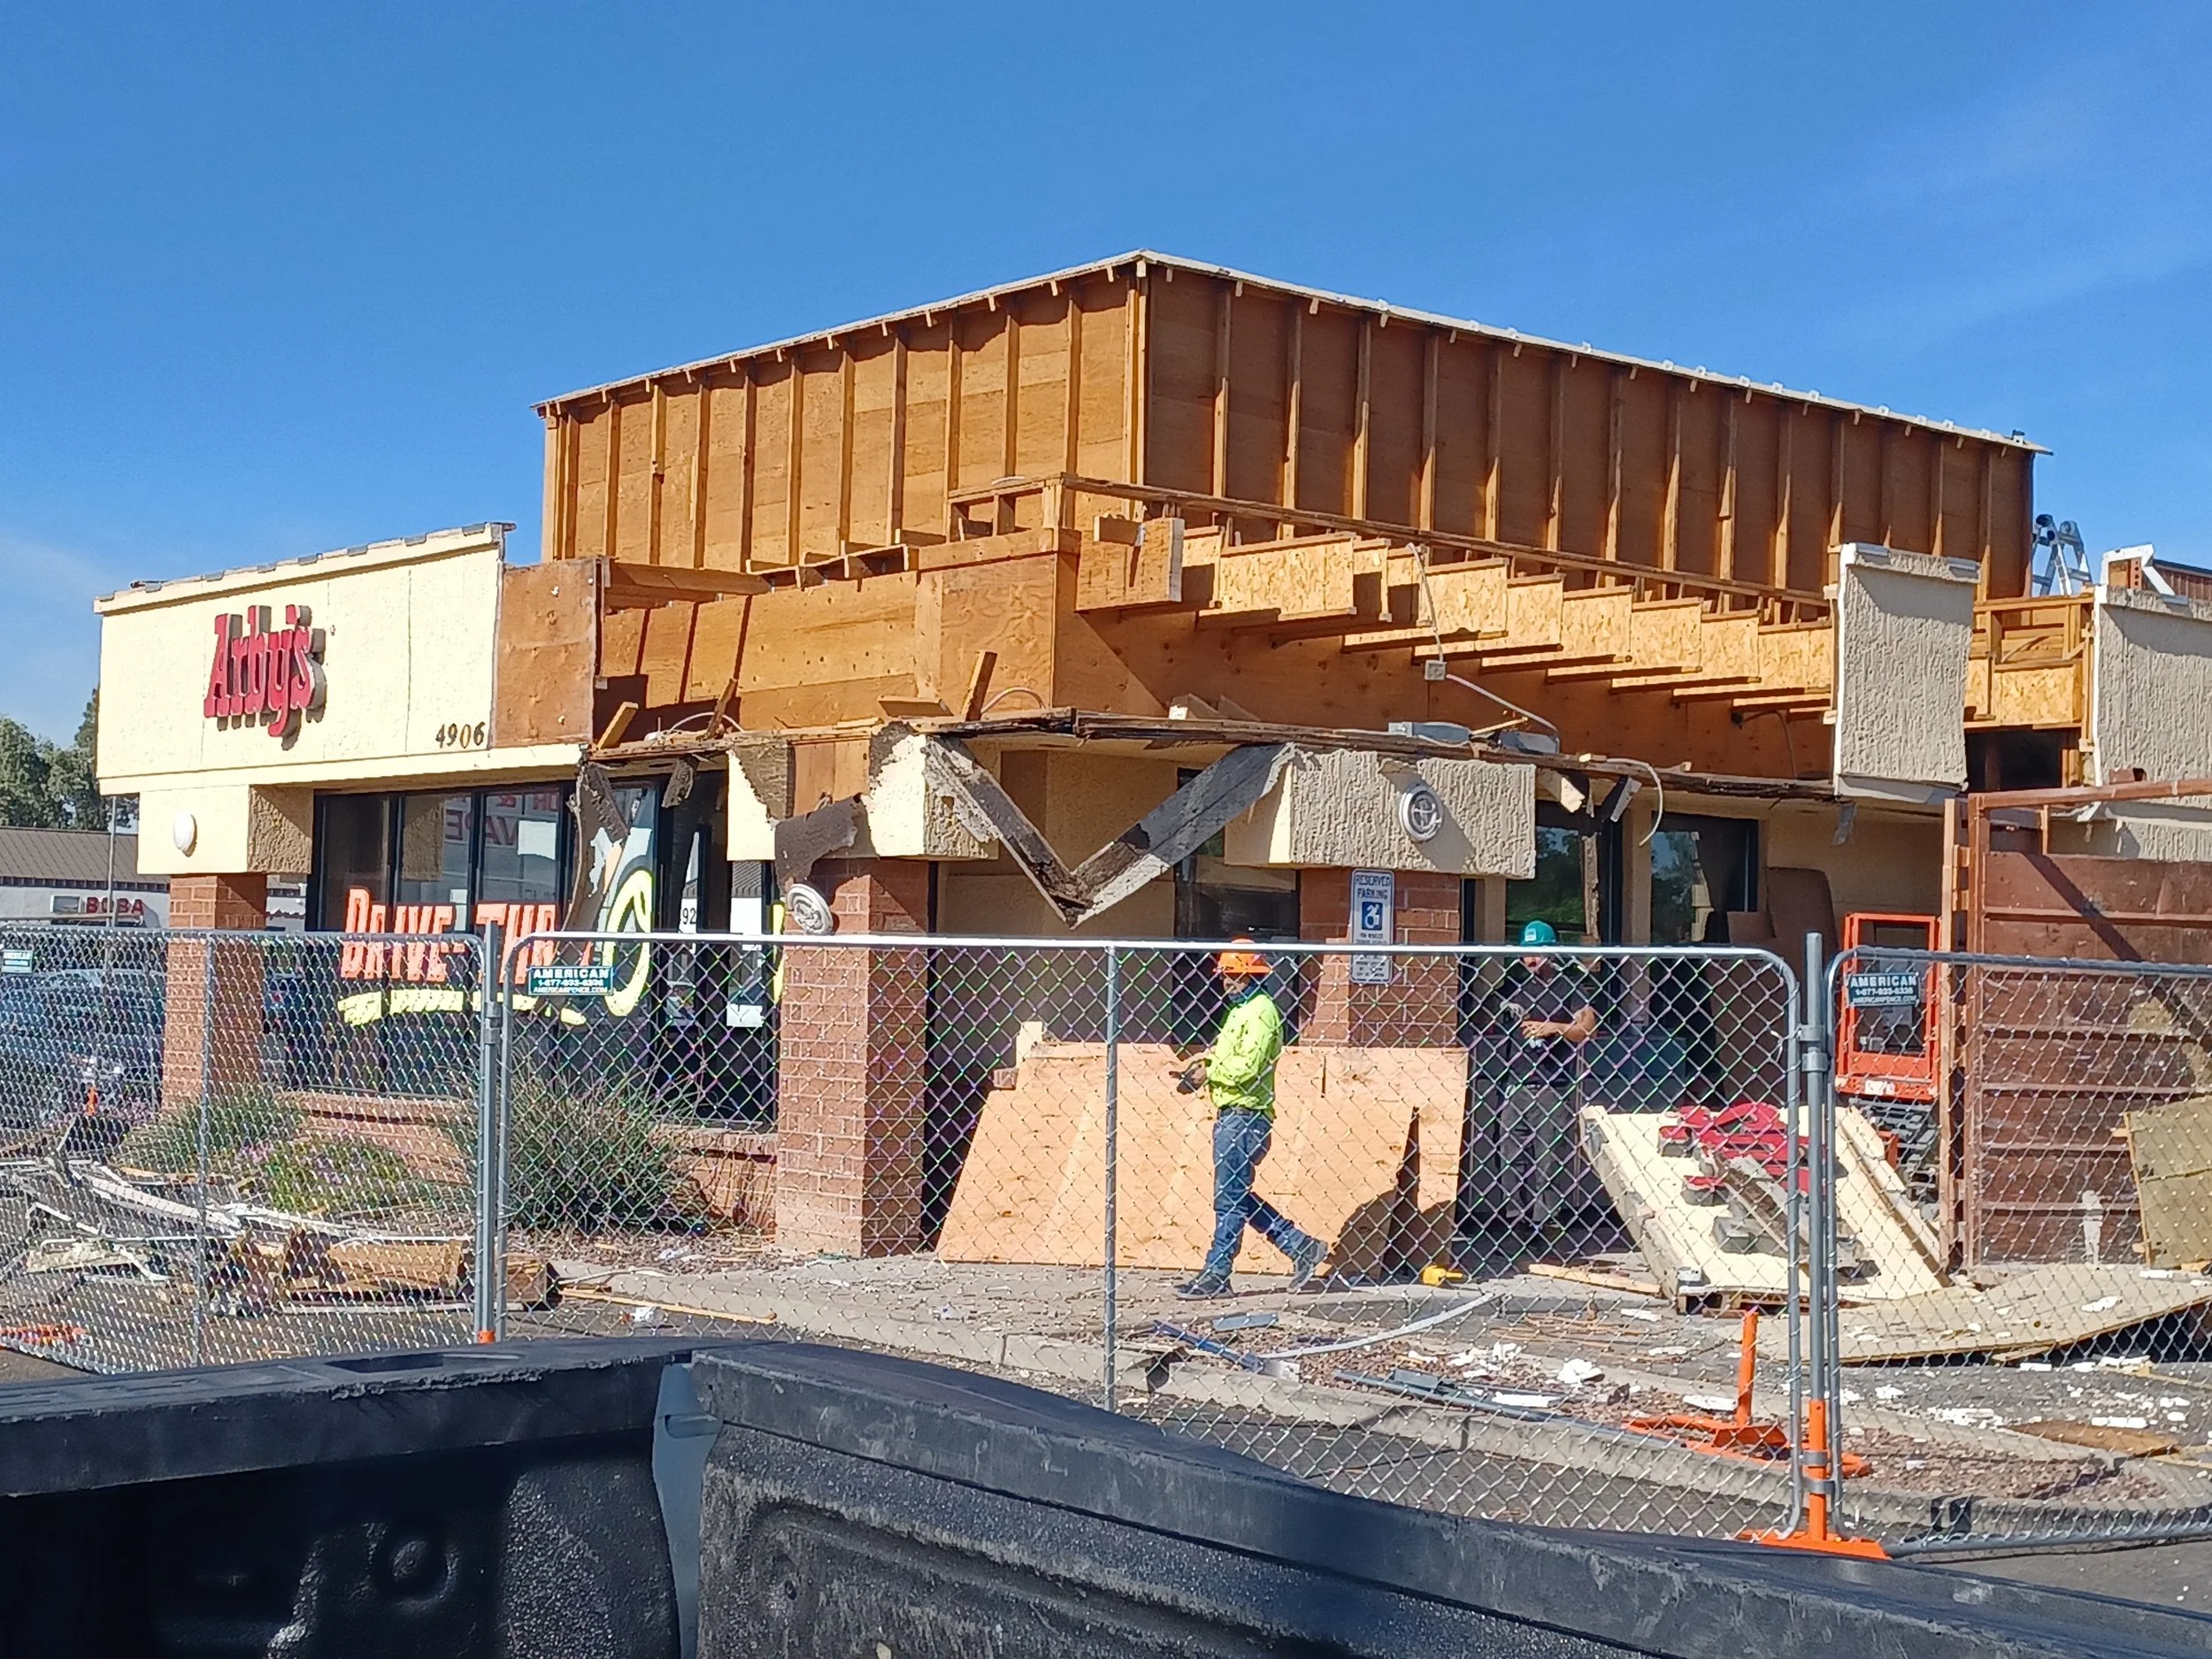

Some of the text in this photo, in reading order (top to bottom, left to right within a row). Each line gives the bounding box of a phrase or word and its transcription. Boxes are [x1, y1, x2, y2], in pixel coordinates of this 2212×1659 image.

[204, 604, 314, 737] Arby's
[435, 721, 486, 749] 4906
[86, 896, 144, 913] BOBA
[534, 969, 610, 979] AMERICAN
[1851, 976, 1916, 987] AMERICAN
